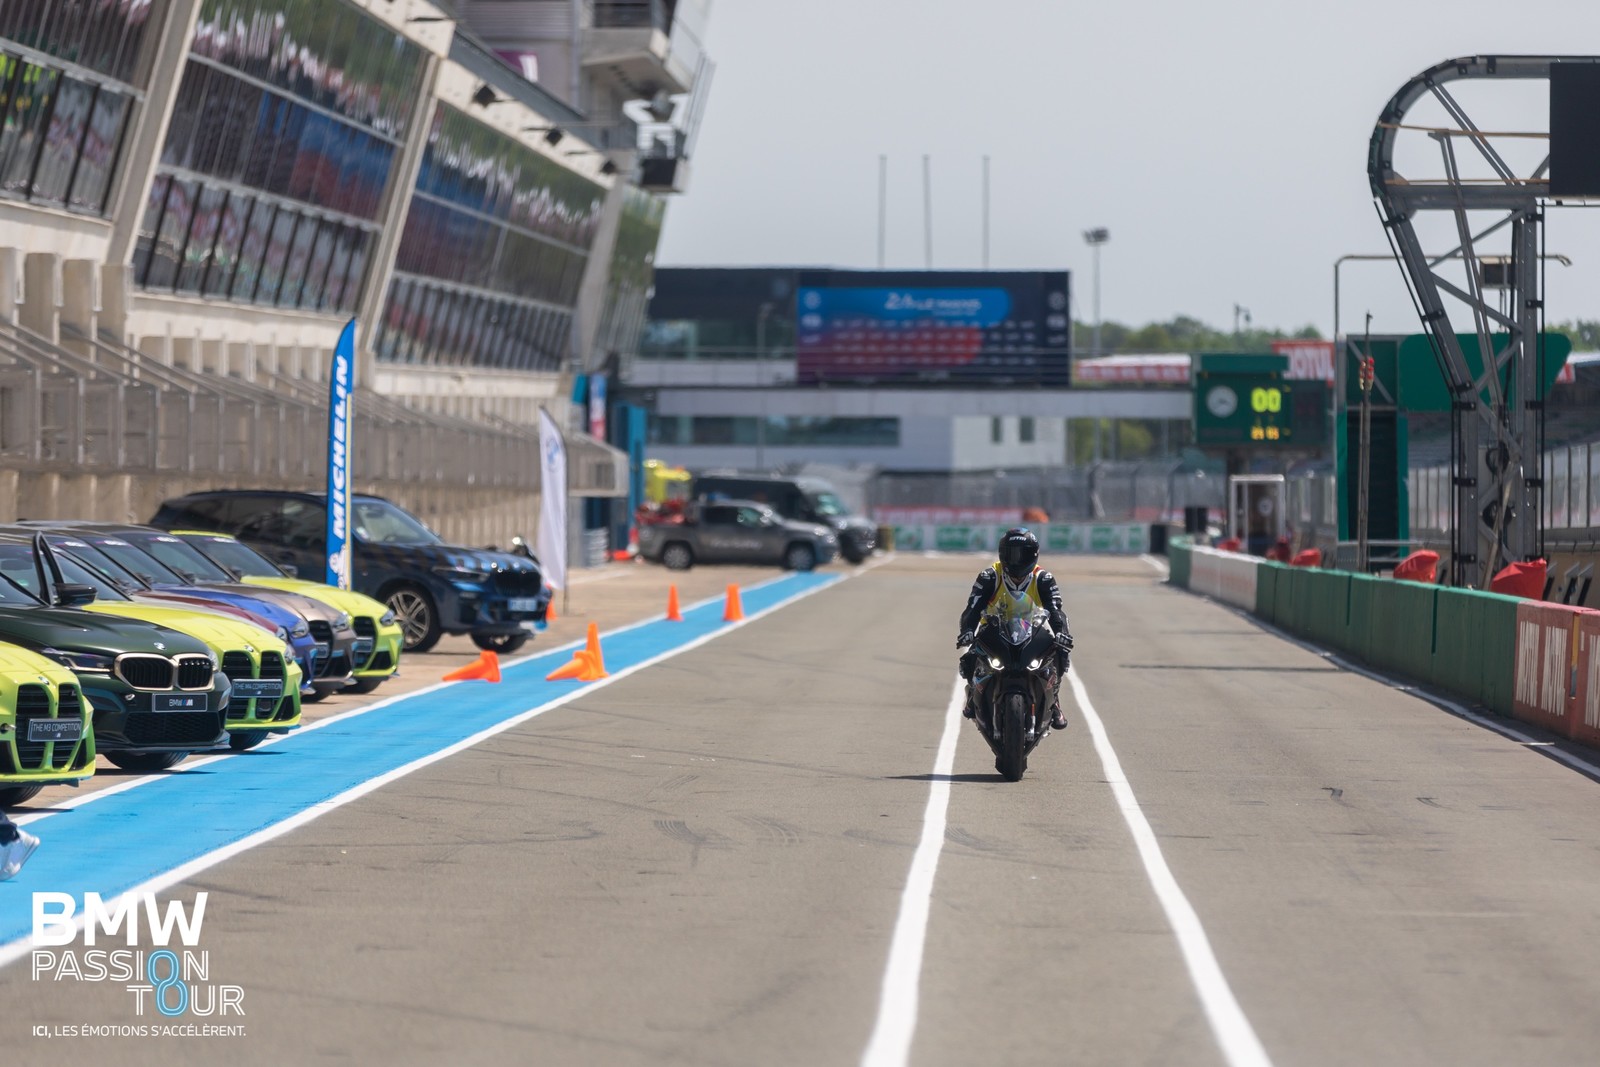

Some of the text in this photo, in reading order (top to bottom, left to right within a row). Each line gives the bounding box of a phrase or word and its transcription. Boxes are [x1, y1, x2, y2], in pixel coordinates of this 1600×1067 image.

[332, 354, 348, 541] MICHELIN
[33, 723, 43, 732] THE
[52, 722, 81, 731] COMPETITION
